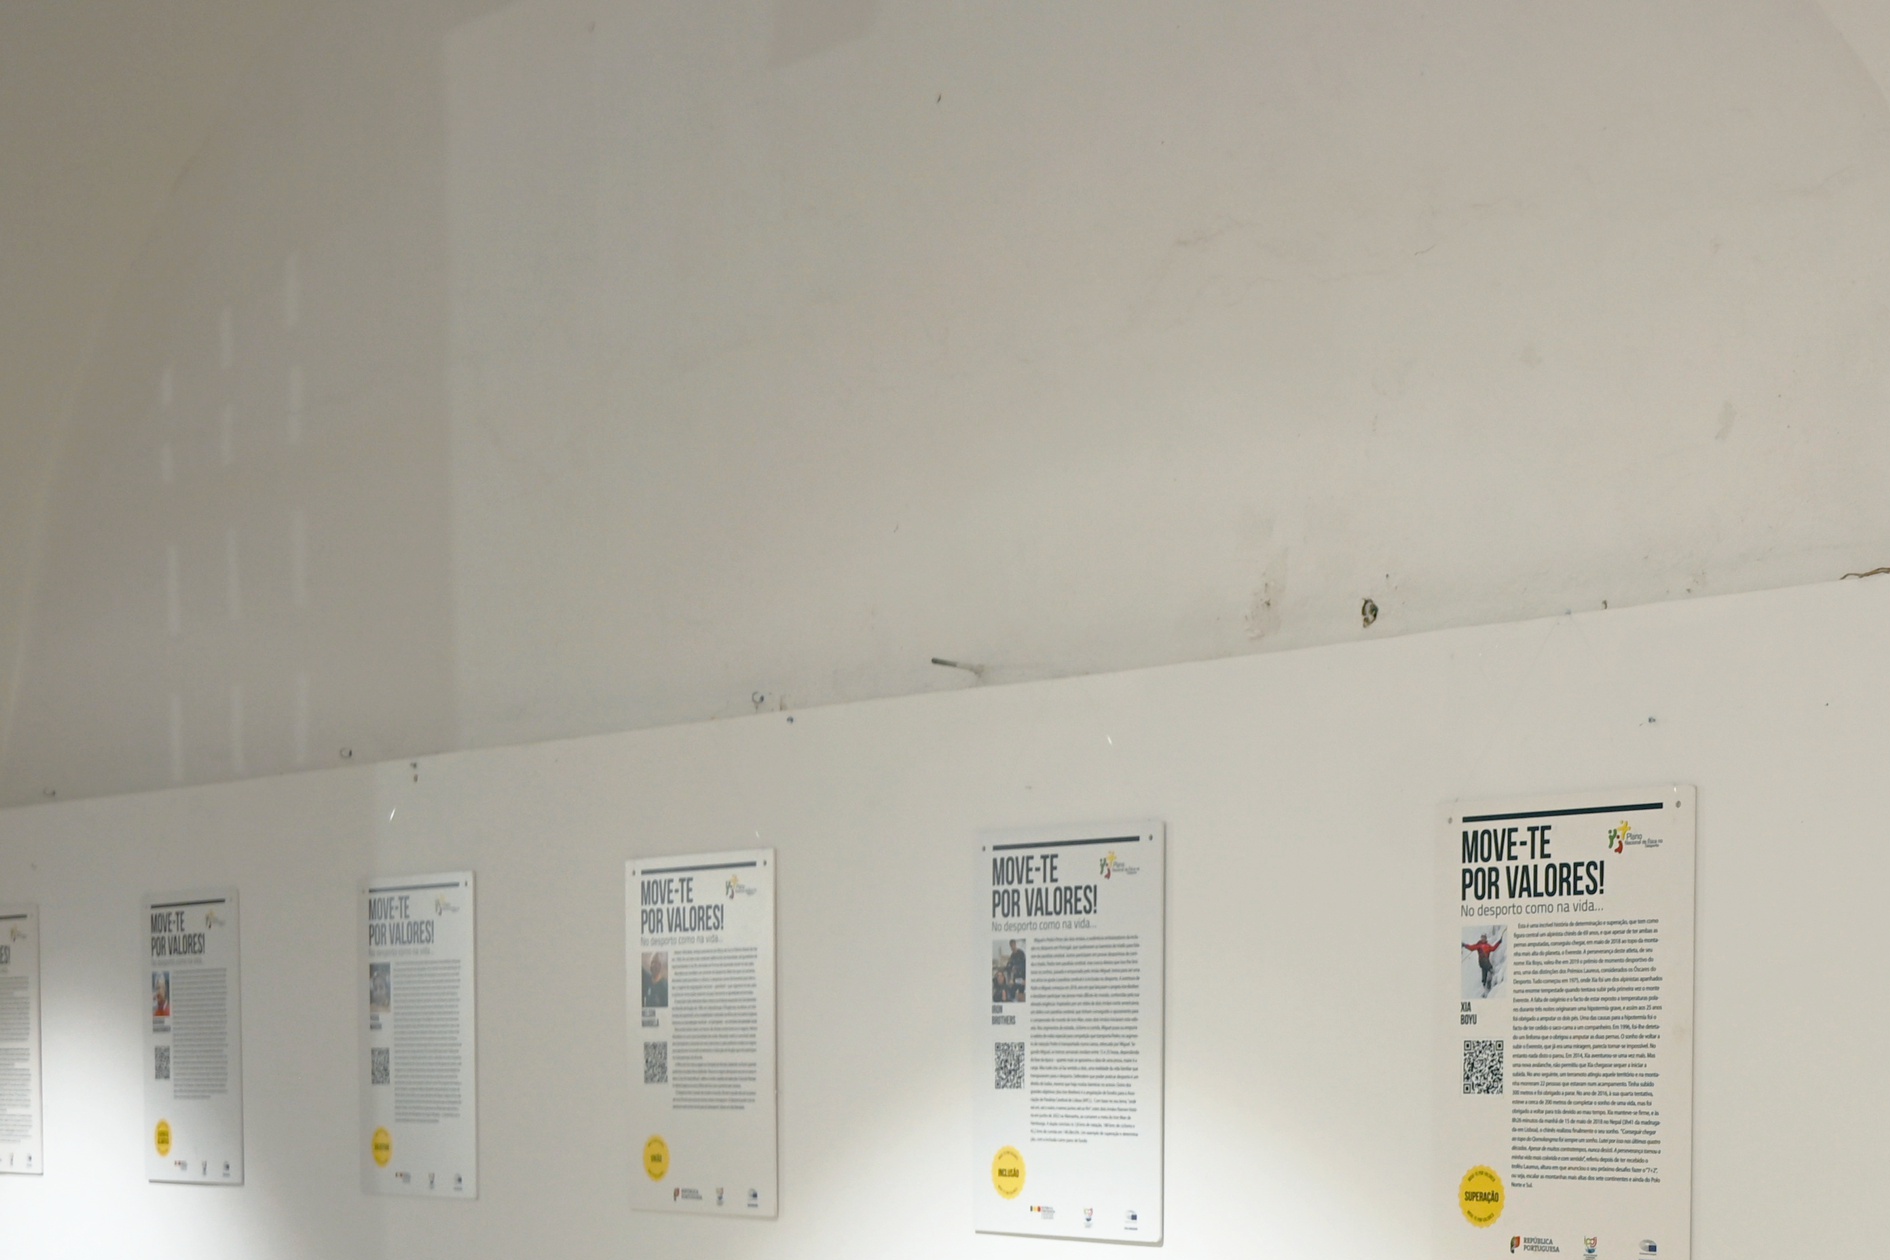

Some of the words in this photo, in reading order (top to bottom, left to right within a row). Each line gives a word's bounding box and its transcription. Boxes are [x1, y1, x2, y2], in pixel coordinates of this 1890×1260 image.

[1462, 825, 1552, 863] MOVE-TE
[992, 854, 1058, 886] MOVE-TE
[1461, 867, 1500, 900] POR
[1506, 860, 1604, 898] VALORES!
[641, 877, 693, 906] MOVE-TE
[992, 889, 1020, 918] POR
[1025, 885, 1097, 917] VALORES!
[369, 896, 410, 920] MOVE-TE
[641, 908, 663, 934] POR
[667, 904, 724, 933] VALORES!
[1460, 904, 1474, 916] No
[1477, 904, 1522, 918] desporto
[1525, 904, 1554, 914] como
[1556, 902, 1570, 912] na
[1572, 899, 1603, 912] vida...
[151, 911, 185, 933] MOVE-TE
[369, 923, 386, 946] POR
[389, 920, 434, 946] VALORES!
[992, 922, 1002, 932] No
[1004, 921, 1037, 933] desporto
[1039, 921, 1061, 930] como
[1062, 921, 1072, 929] na
[151, 935, 166, 957] POR
[168, 932, 205, 956] VALORES!
[1461, 1001, 1471, 1012] XIA
[1460, 1014, 1477, 1025] BOYU
[1464, 1190, 1499, 1204] SUPERAÇÃO
[1523, 1236, 1553, 1245] REPÚBLICA
[1523, 1245, 1560, 1253] PORTUGUESA
